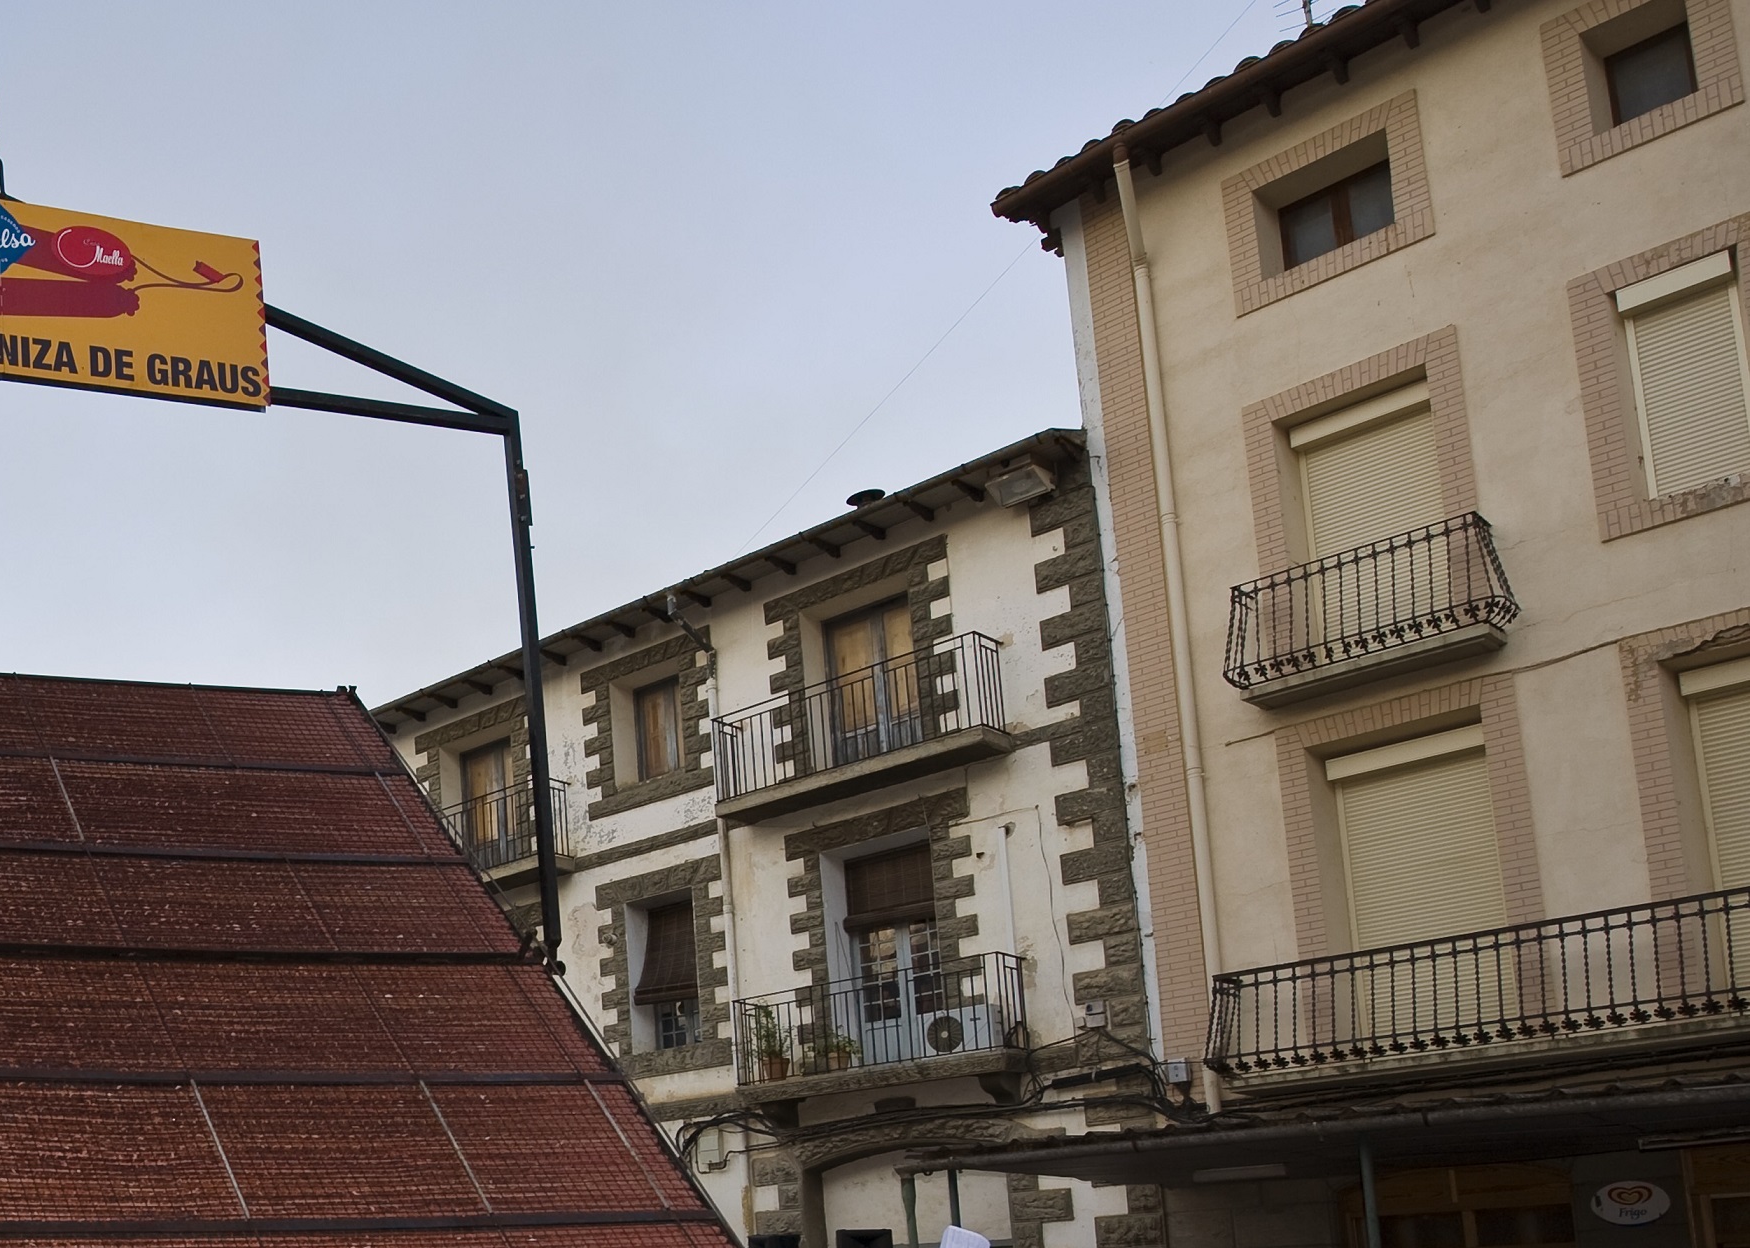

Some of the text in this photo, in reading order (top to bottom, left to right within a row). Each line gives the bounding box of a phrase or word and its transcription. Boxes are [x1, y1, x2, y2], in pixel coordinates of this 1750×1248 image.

[95, 245, 124, 266] Maella
[89, 344, 135, 382] DE
[146, 352, 262, 398] GRAUS
[1618, 1207, 1648, 1220] Frigo
